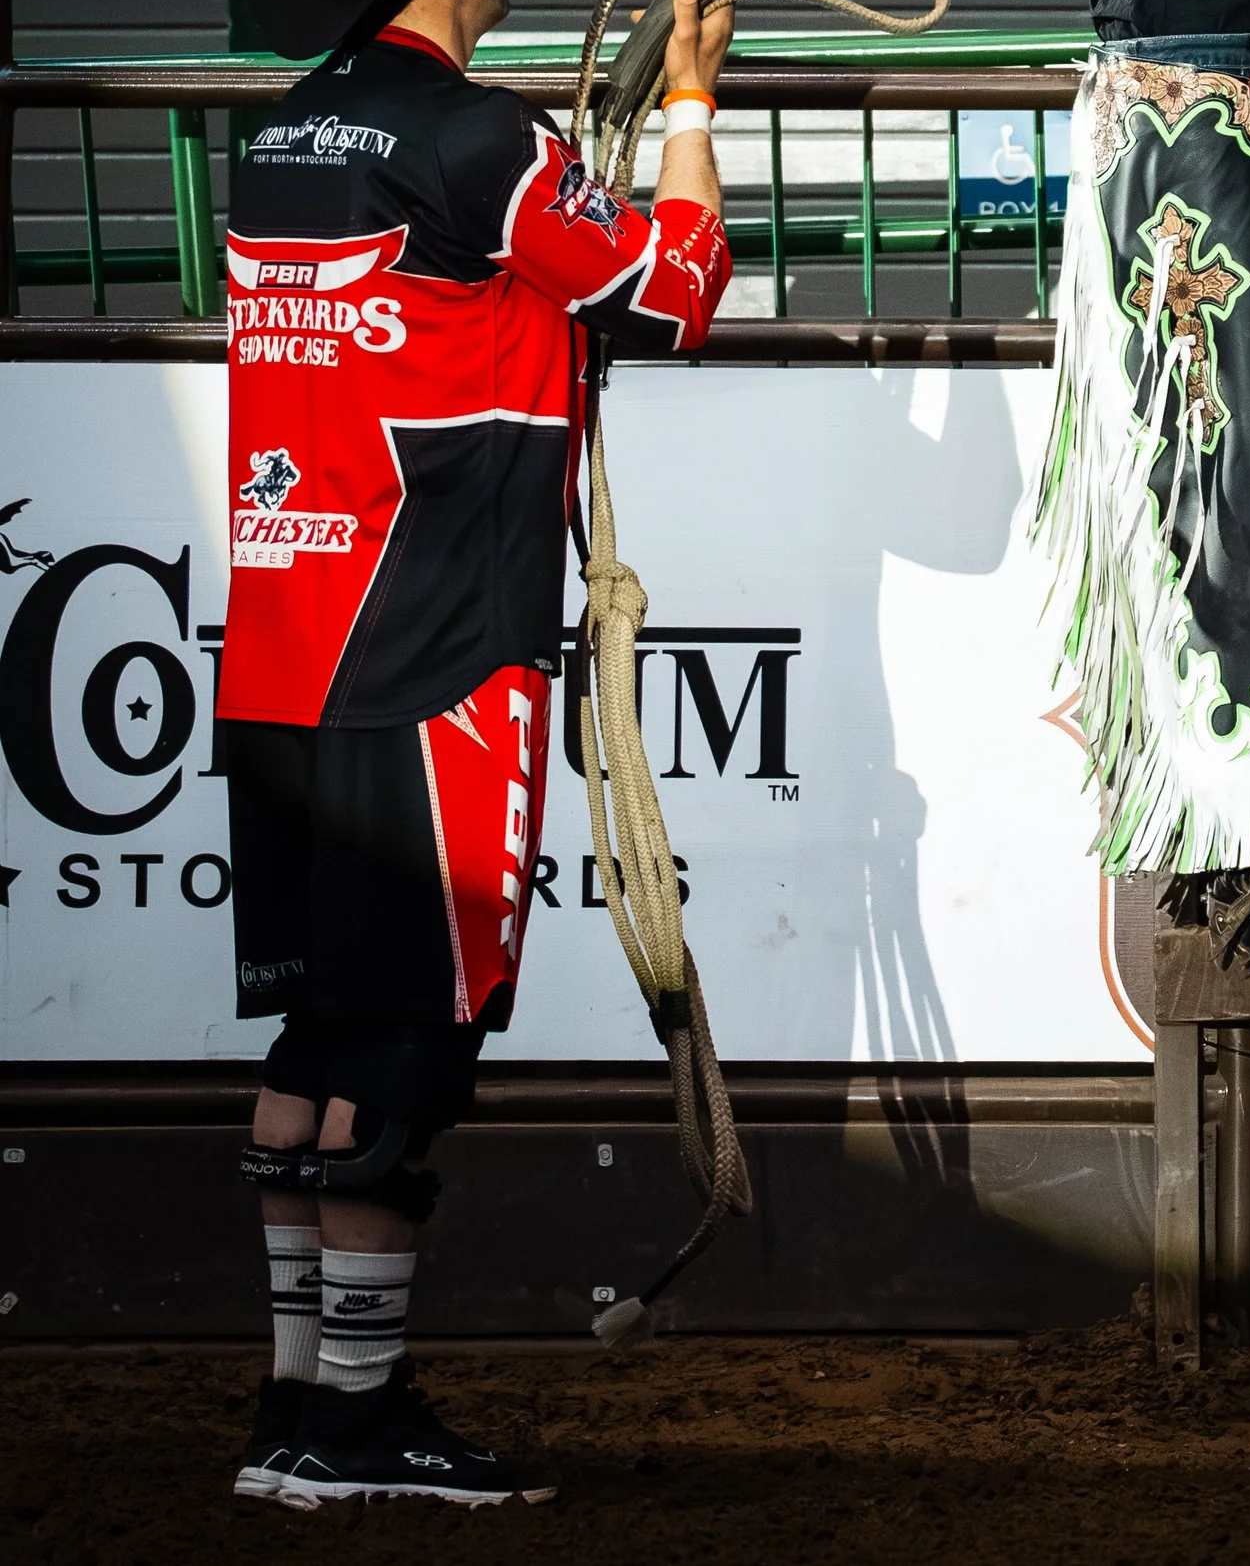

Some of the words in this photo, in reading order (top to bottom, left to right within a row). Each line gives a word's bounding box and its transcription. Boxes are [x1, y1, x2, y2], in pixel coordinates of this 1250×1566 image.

[253, 154, 270, 164] FORT
[271, 154, 295, 164] WORTH
[301, 155, 348, 166] STOCKYARDS
[259, 264, 314, 284] PBR
[238, 335, 340, 368] SHOWCASE
[768, 784, 800, 802] TM
[342, 1292, 382, 1308] NIKE
